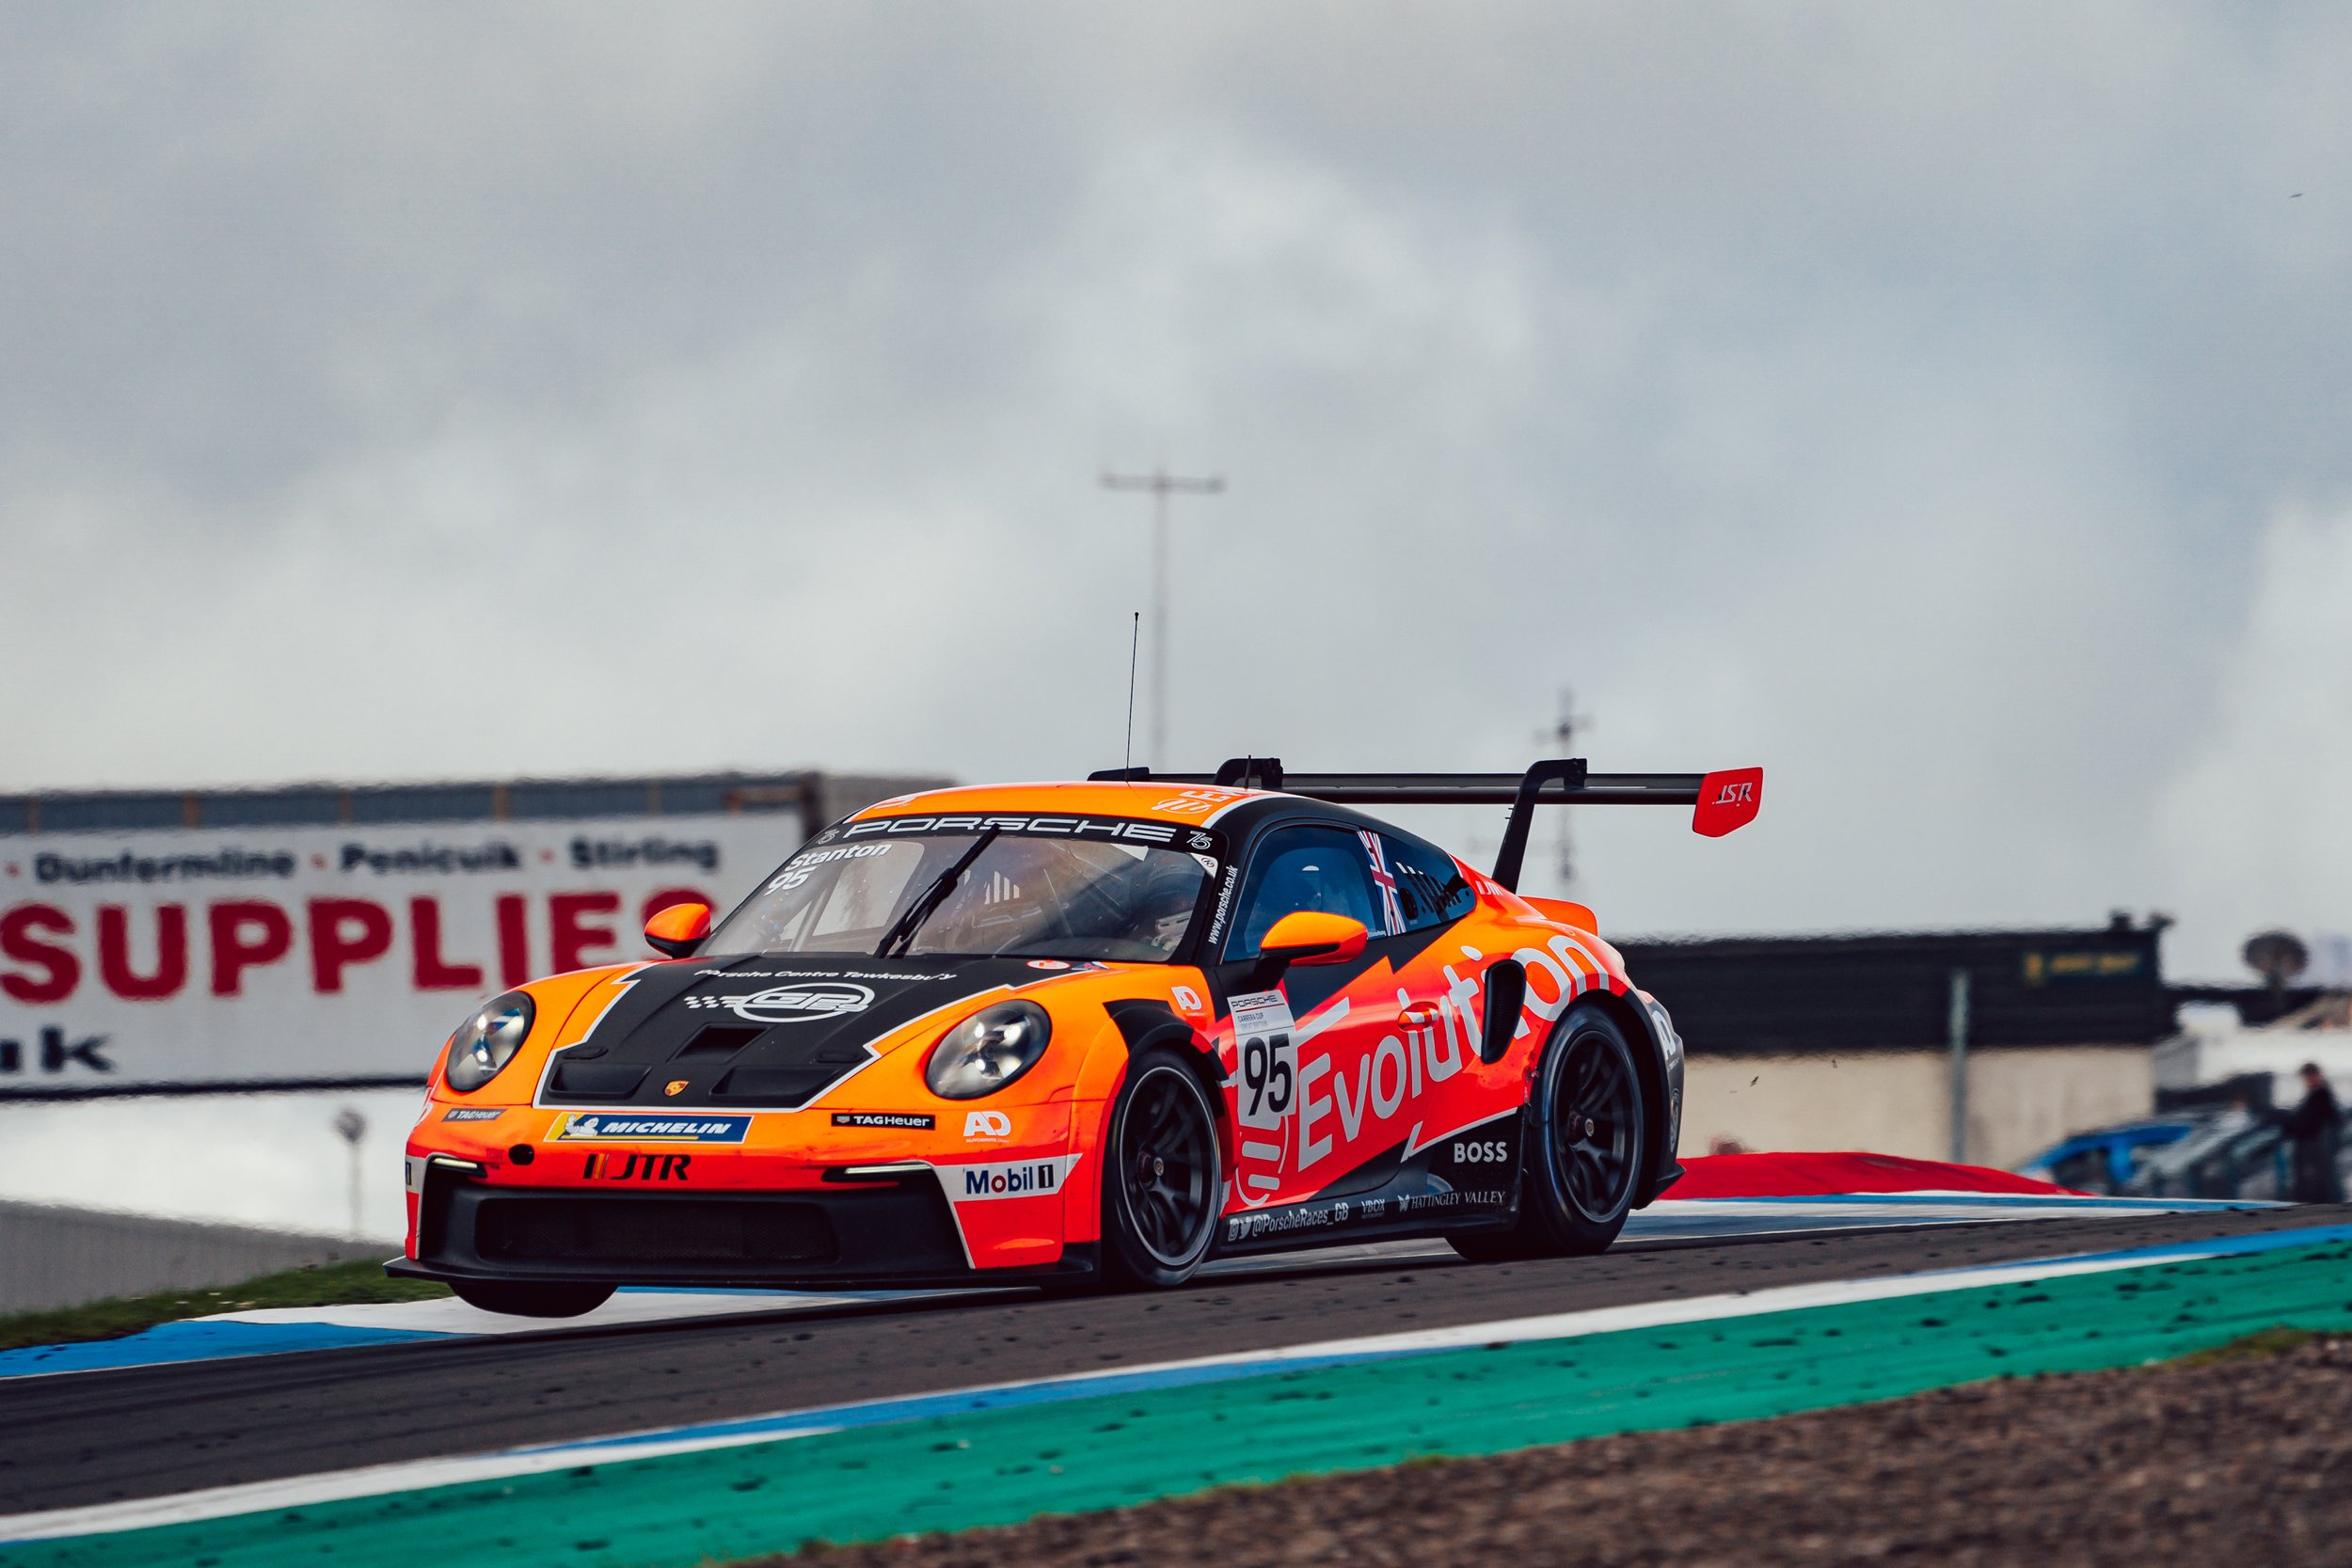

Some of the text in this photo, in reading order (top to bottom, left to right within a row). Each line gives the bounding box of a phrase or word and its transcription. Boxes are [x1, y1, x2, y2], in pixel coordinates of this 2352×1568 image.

[843, 816, 1177, 843] PORSCHE
[1186, 830, 1213, 849] 75
[36, 836, 719, 883] Dunfermline Penicuik Stirling
[785, 844, 892, 872] Stanton
[764, 865, 817, 896] 95
[1208, 864, 1239, 944] www.porsche.co.uk
[0, 884, 719, 1004] SUPPLIE
[693, 969, 771, 977] Porsche
[1231, 994, 1279, 1007] PORSCHE
[1244, 1033, 1293, 1117] 95
[601, 1121, 732, 1134] MICHELIN
[853, 1115, 930, 1127] TAGHeuer
[1454, 1141, 1508, 1164] BOSS
[965, 1165, 1033, 1195] Mobil
[1360, 1198, 1386, 1214] VBOX
[1411, 1191, 1506, 1210] HATTINGLEY VALLEY
[1252, 1201, 1349, 1237] @PorscheRaces_GB
